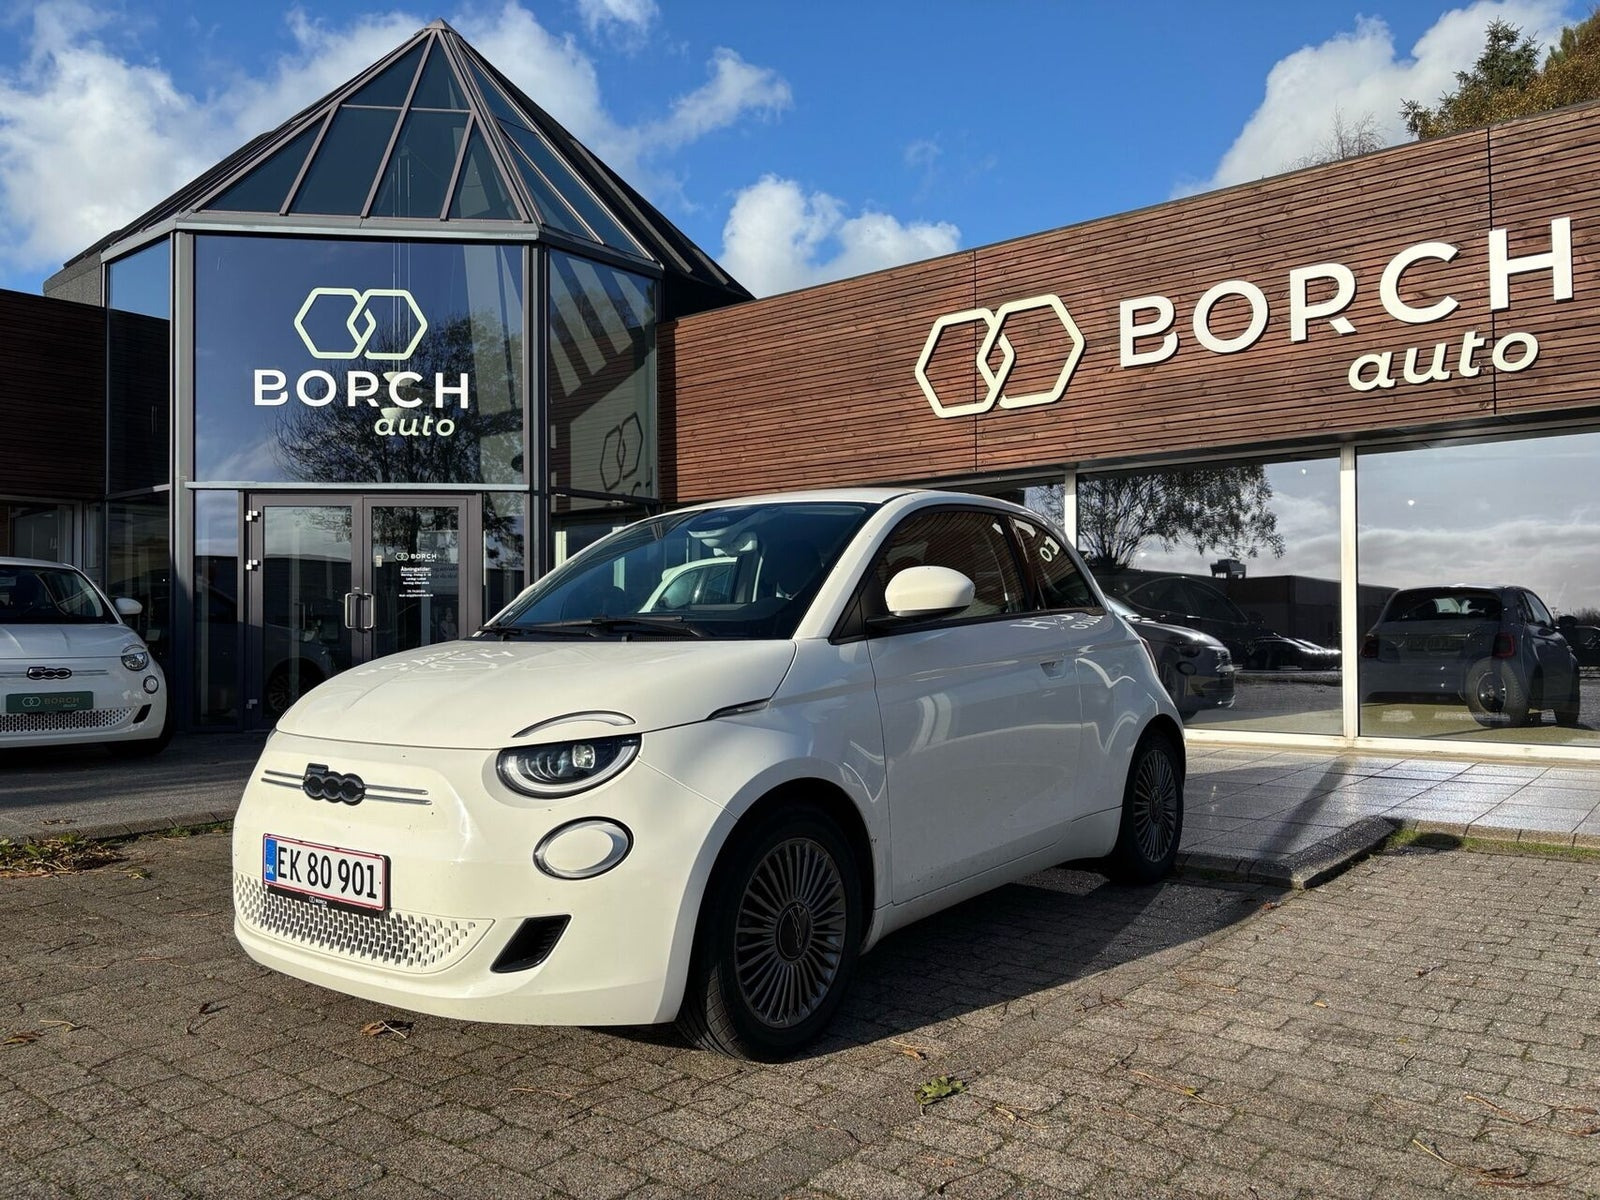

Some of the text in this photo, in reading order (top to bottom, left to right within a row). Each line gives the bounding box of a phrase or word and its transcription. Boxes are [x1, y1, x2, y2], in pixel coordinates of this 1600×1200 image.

[1119, 216, 1574, 369] BORCH
[1347, 329, 1540, 392] auto
[254, 369, 469, 409] BORCH
[374, 415, 455, 437] auto
[277, 846, 377, 900] EK 80 901
